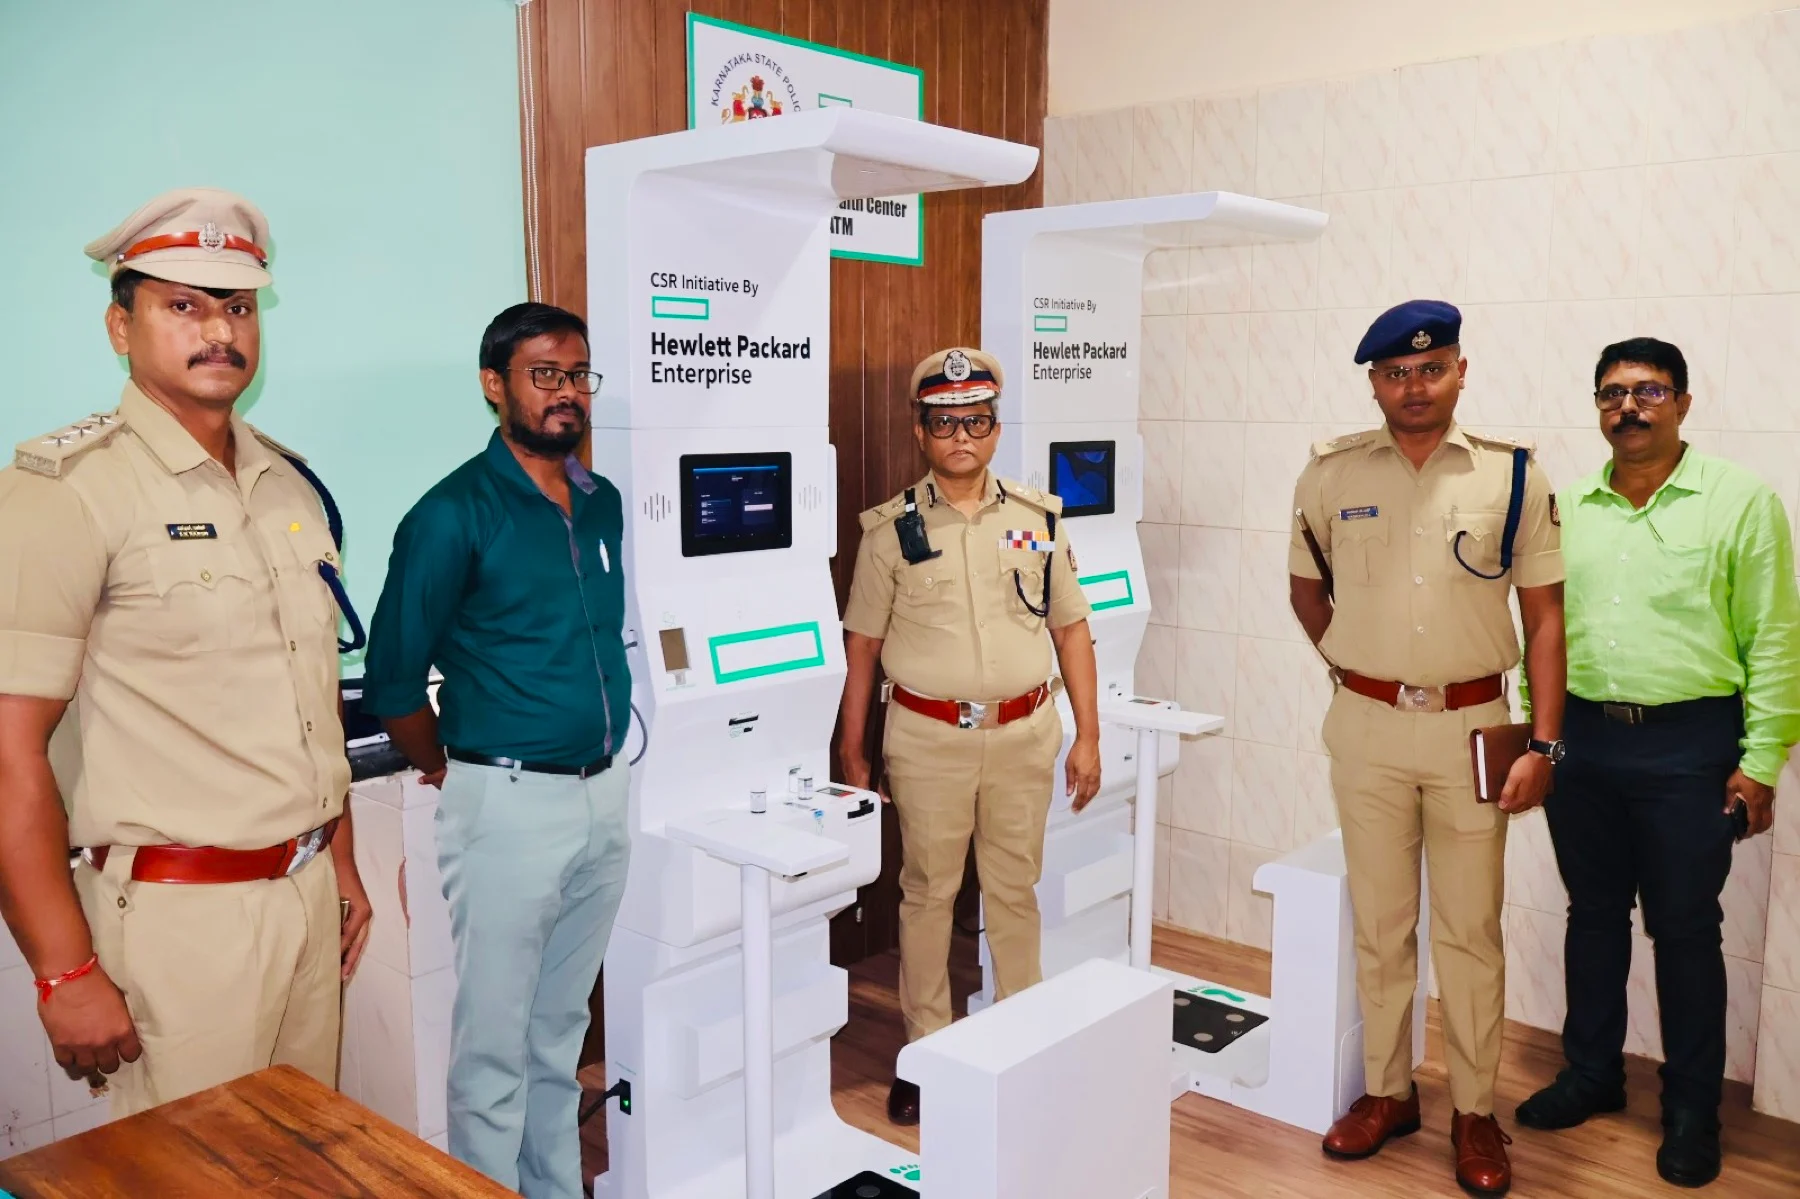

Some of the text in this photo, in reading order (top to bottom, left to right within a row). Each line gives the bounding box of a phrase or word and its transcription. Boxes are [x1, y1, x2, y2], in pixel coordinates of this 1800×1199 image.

[711, 53, 801, 112] KARNATAKA STATE POLIC
[837, 197, 907, 217] alth Center
[650, 272, 759, 297] CSR Initiative By
[1033, 298, 1097, 313] CSR Initiative By
[651, 332, 811, 359] Hewlett Packard
[1033, 341, 1126, 360] Hewlett Packard
[651, 361, 752, 389] Enterprise
[1033, 363, 1092, 384] Enterprise
